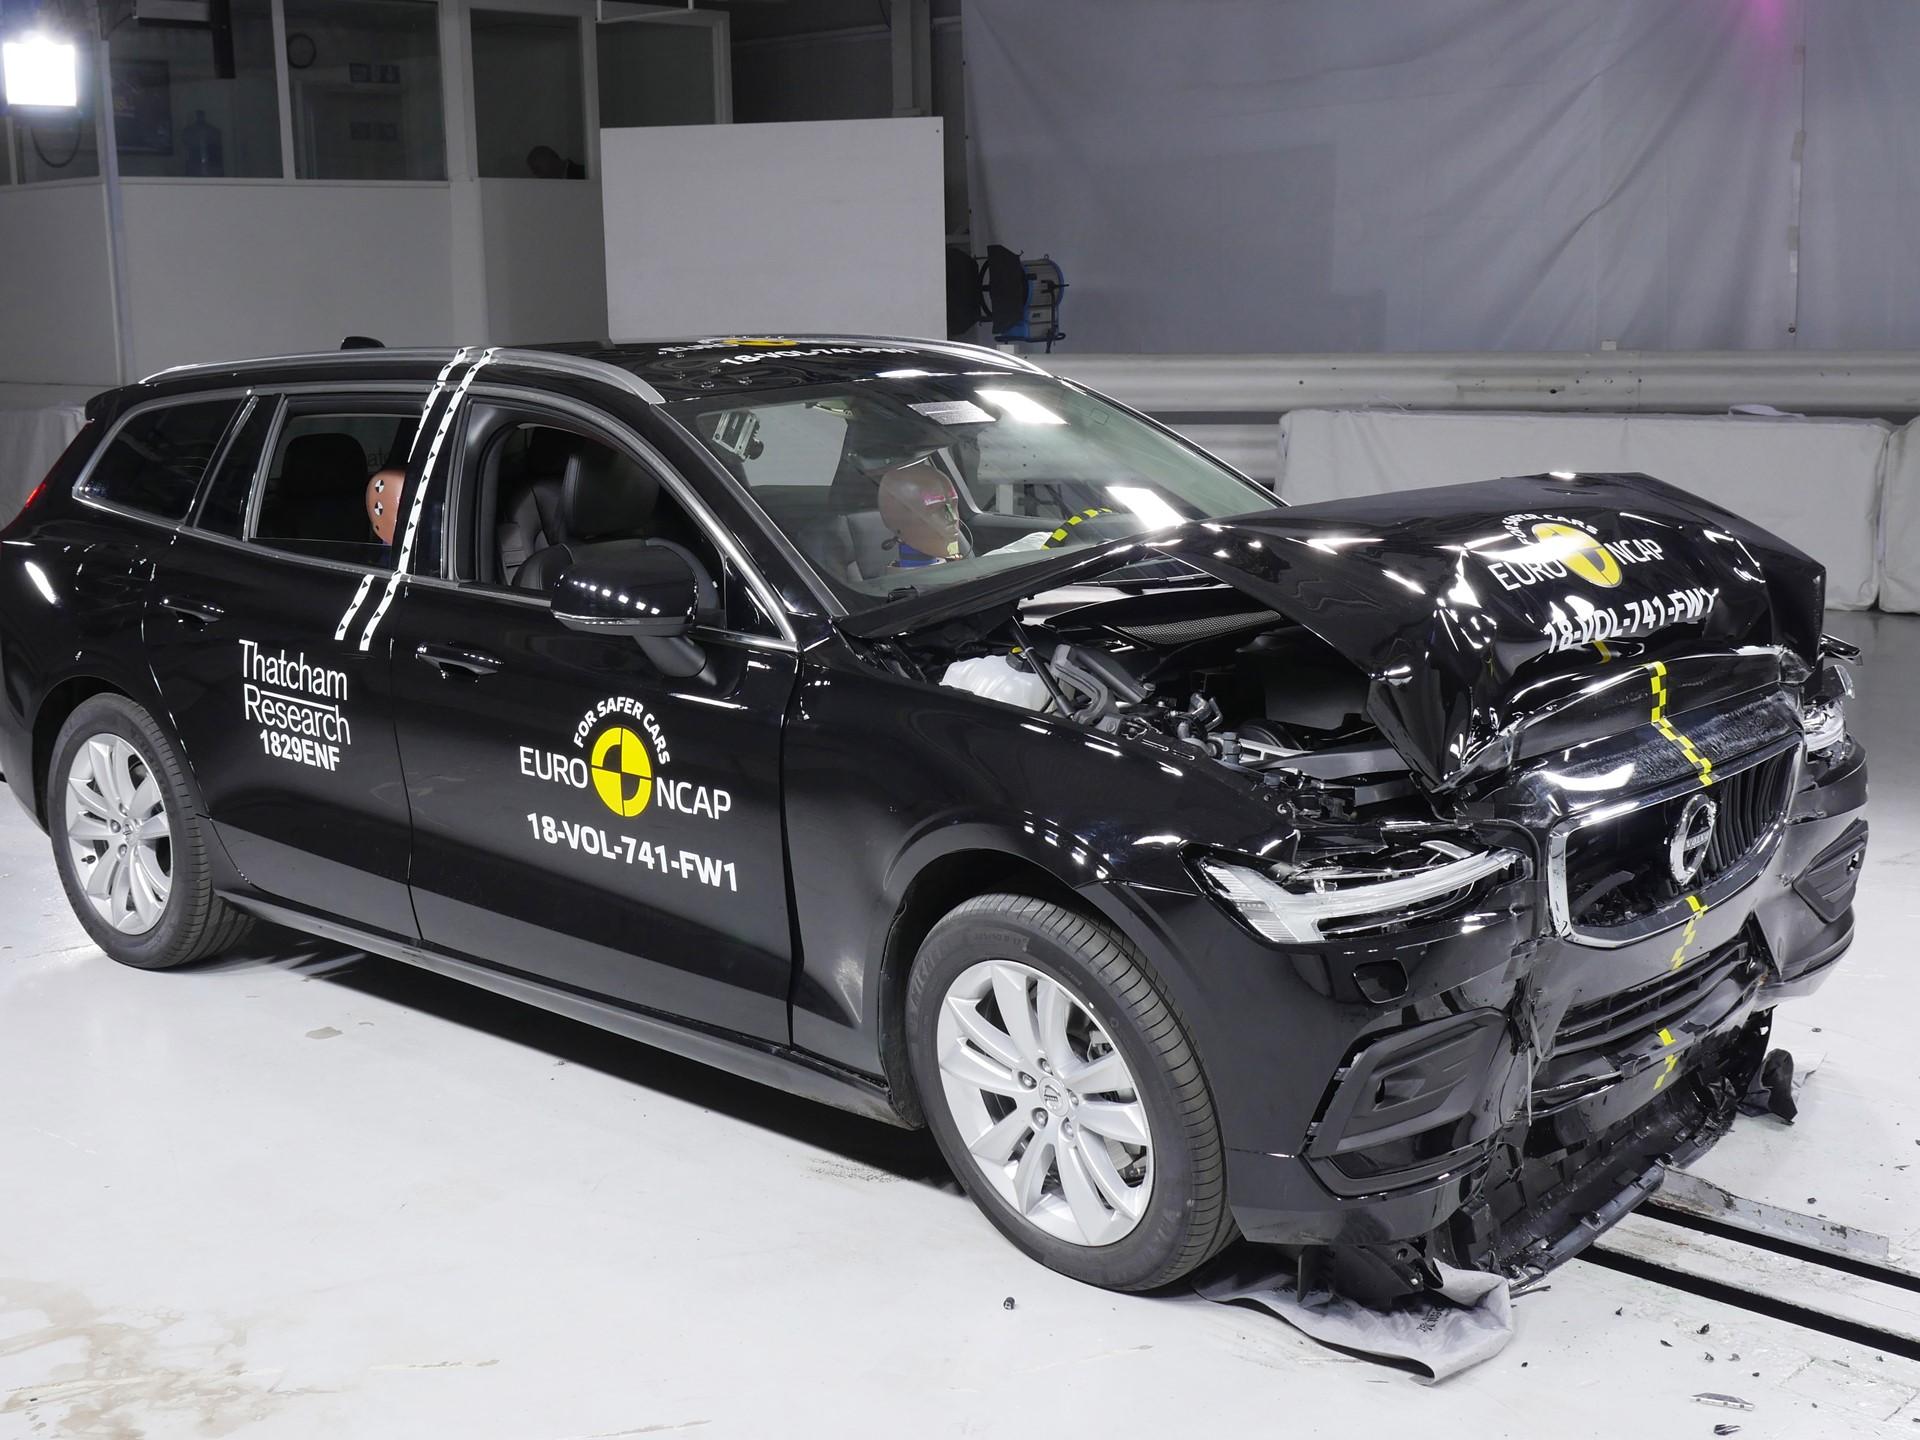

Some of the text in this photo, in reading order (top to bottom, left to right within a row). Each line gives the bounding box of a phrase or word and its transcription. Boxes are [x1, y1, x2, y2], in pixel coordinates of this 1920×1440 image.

[720, 347, 919, 366] 18-VOL-741-FW1
[1542, 514, 1599, 535] CARS
[1488, 538, 1664, 591] EURO NCAP
[1543, 587, 1719, 654] 18-VOL-741-FW1
[238, 639, 348, 701] Thatcham
[243, 683, 351, 745] Research
[573, 696, 671, 765] FOR SAFER CARS
[259, 729, 340, 771] 1829ENF
[519, 745, 732, 820] EURO NCAP
[526, 812, 738, 892] 18-VOL-741-FW1
